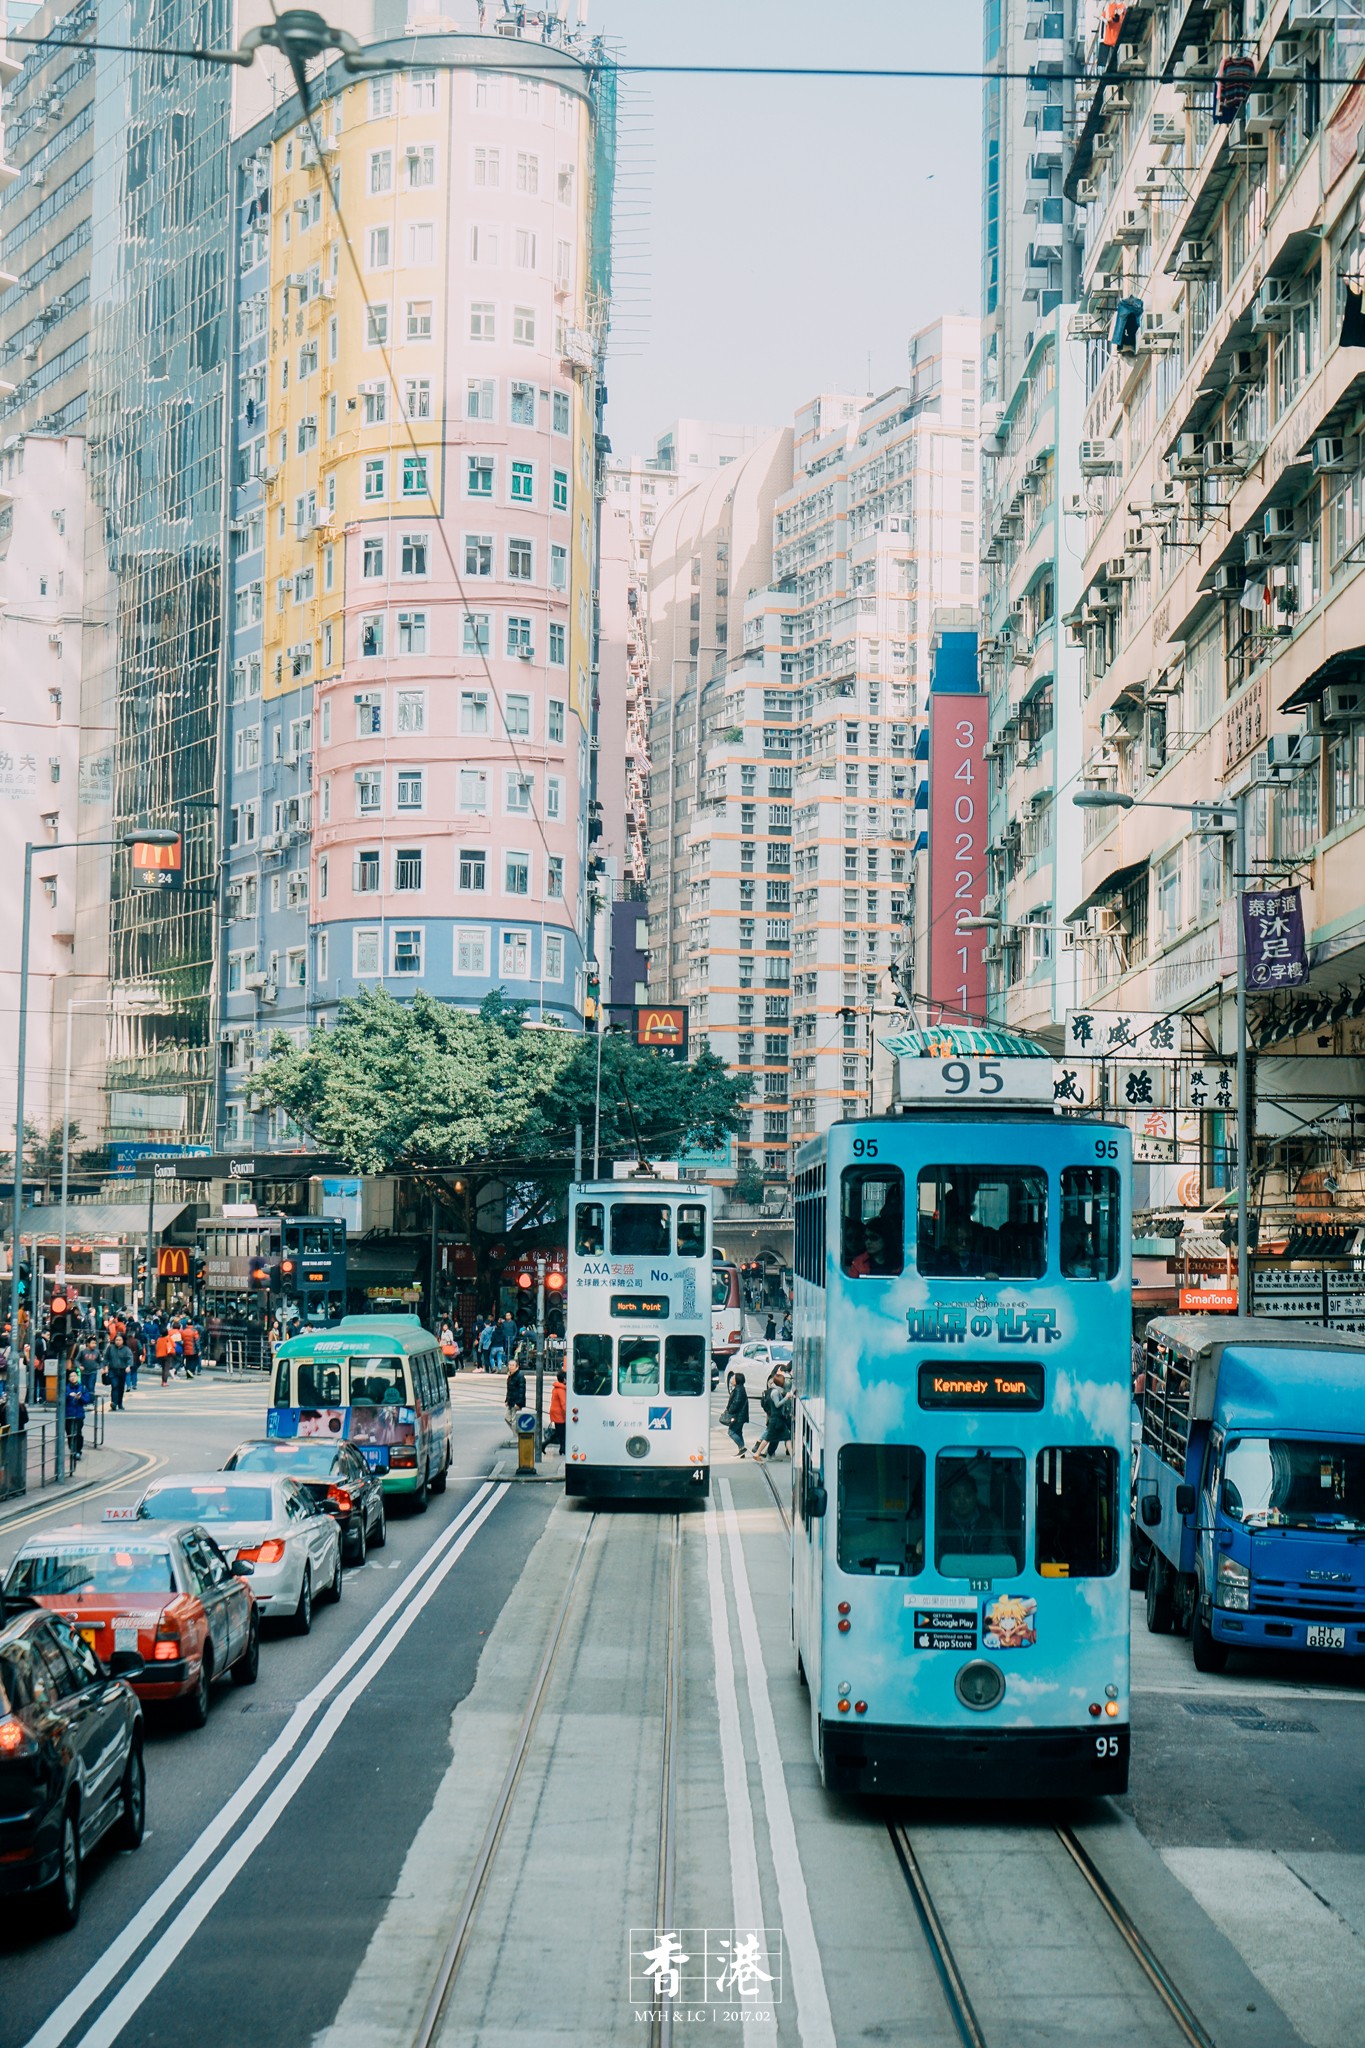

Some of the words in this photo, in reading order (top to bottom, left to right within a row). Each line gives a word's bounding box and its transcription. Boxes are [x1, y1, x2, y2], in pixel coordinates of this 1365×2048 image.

[158, 872, 172, 883] 24
[1249, 895, 1297, 917] 泰舒適
[1259, 917, 1292, 961] 沐足
[1071, 1014, 1175, 1050] 羅威強
[662, 1048, 674, 1058] 24
[941, 1062, 1004, 1094] 95
[1053, 1070, 1084, 1104] 威
[1125, 1070, 1154, 1105] 強
[852, 1138, 878, 1158] 95
[1094, 1140, 1118, 1160] 95
[154, 1163, 176, 1178] Gourami
[230, 1159, 255, 1175] Gourami
[576, 1184, 586, 1194] 41
[686, 1184, 697, 1195] 41
[576, 1278, 643, 1288] 全球最大保險公司
[1185, 1294, 1233, 1304] SmarTone
[617, 1302, 637, 1310] North
[642, 1302, 662, 1311] Point
[1330, 1300, 1342, 1312] 9/F
[934, 1378, 988, 1395] Kennedy
[994, 1378, 1026, 1393] Town
[648, 1418, 668, 1428] AXA
[692, 1470, 704, 1481] 41
[106, 1510, 133, 1518] TAXI
[1306, 1570, 1352, 1582] ISUZU
[972, 1580, 989, 1590] 113
[932, 1618, 958, 1628] Google
[959, 1618, 974, 1628] Play
[1318, 1626, 1334, 1638] HT
[932, 1640, 950, 1650] App
[951, 1640, 972, 1648] Store
[1309, 1635, 1342, 1648] 8896
[1096, 1736, 1120, 1758] 95
